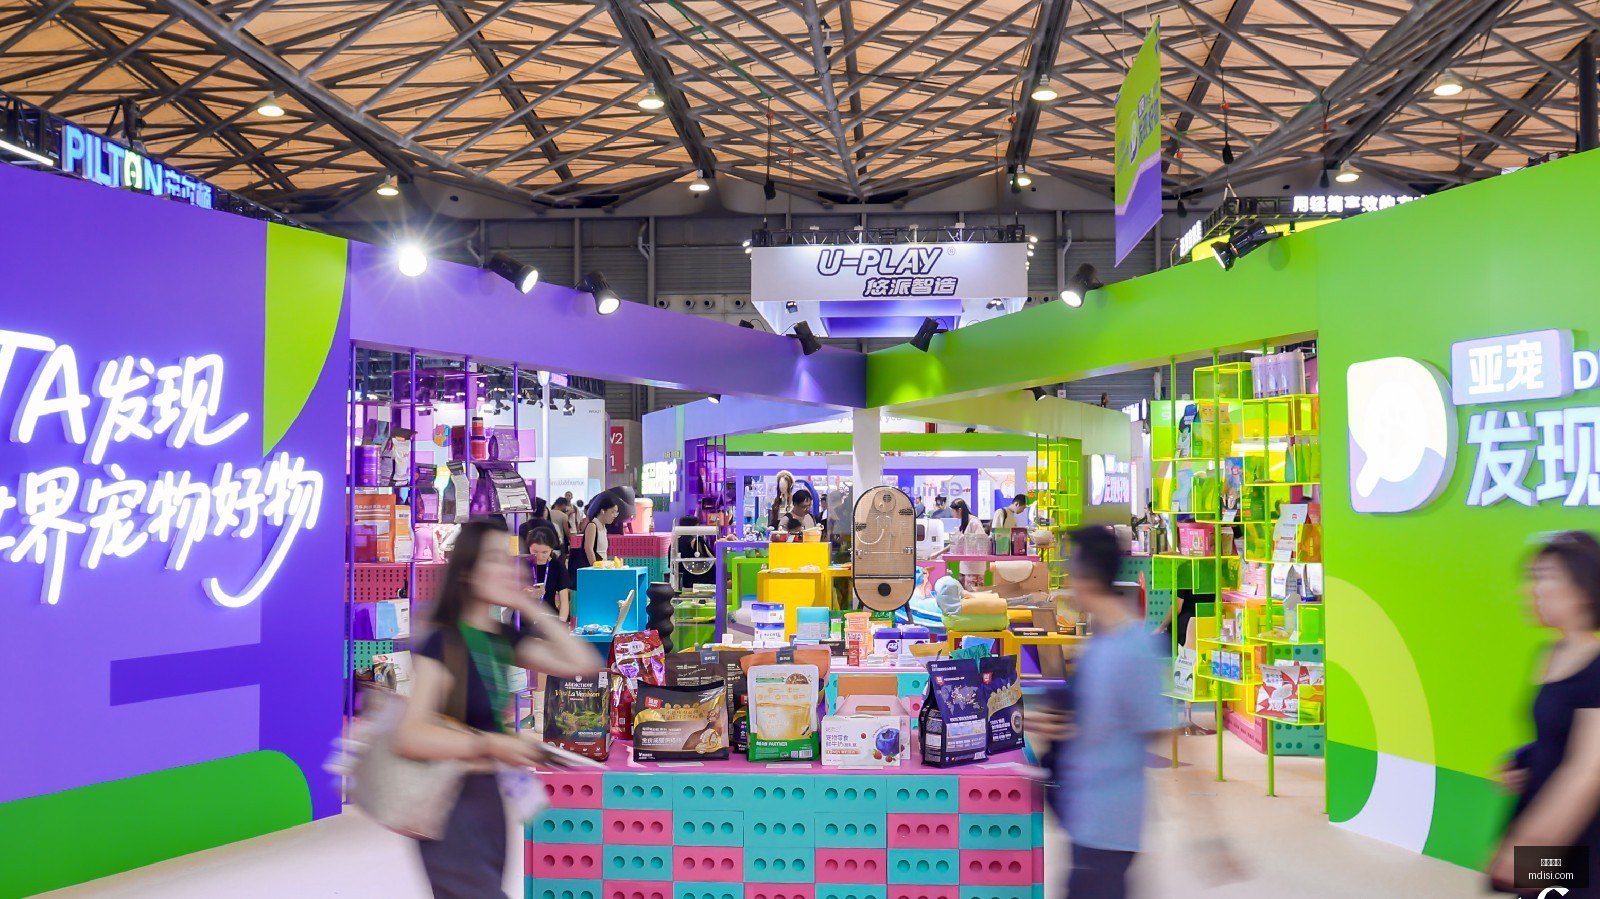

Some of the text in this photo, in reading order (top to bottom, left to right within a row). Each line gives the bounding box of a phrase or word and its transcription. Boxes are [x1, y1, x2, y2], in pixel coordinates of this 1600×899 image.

[62, 124, 163, 196] PILTAN
[817, 247, 943, 276] U-PLAY
[863, 276, 958, 297] 悠派智造
[1468, 339, 1600, 395] 亚宠 D
